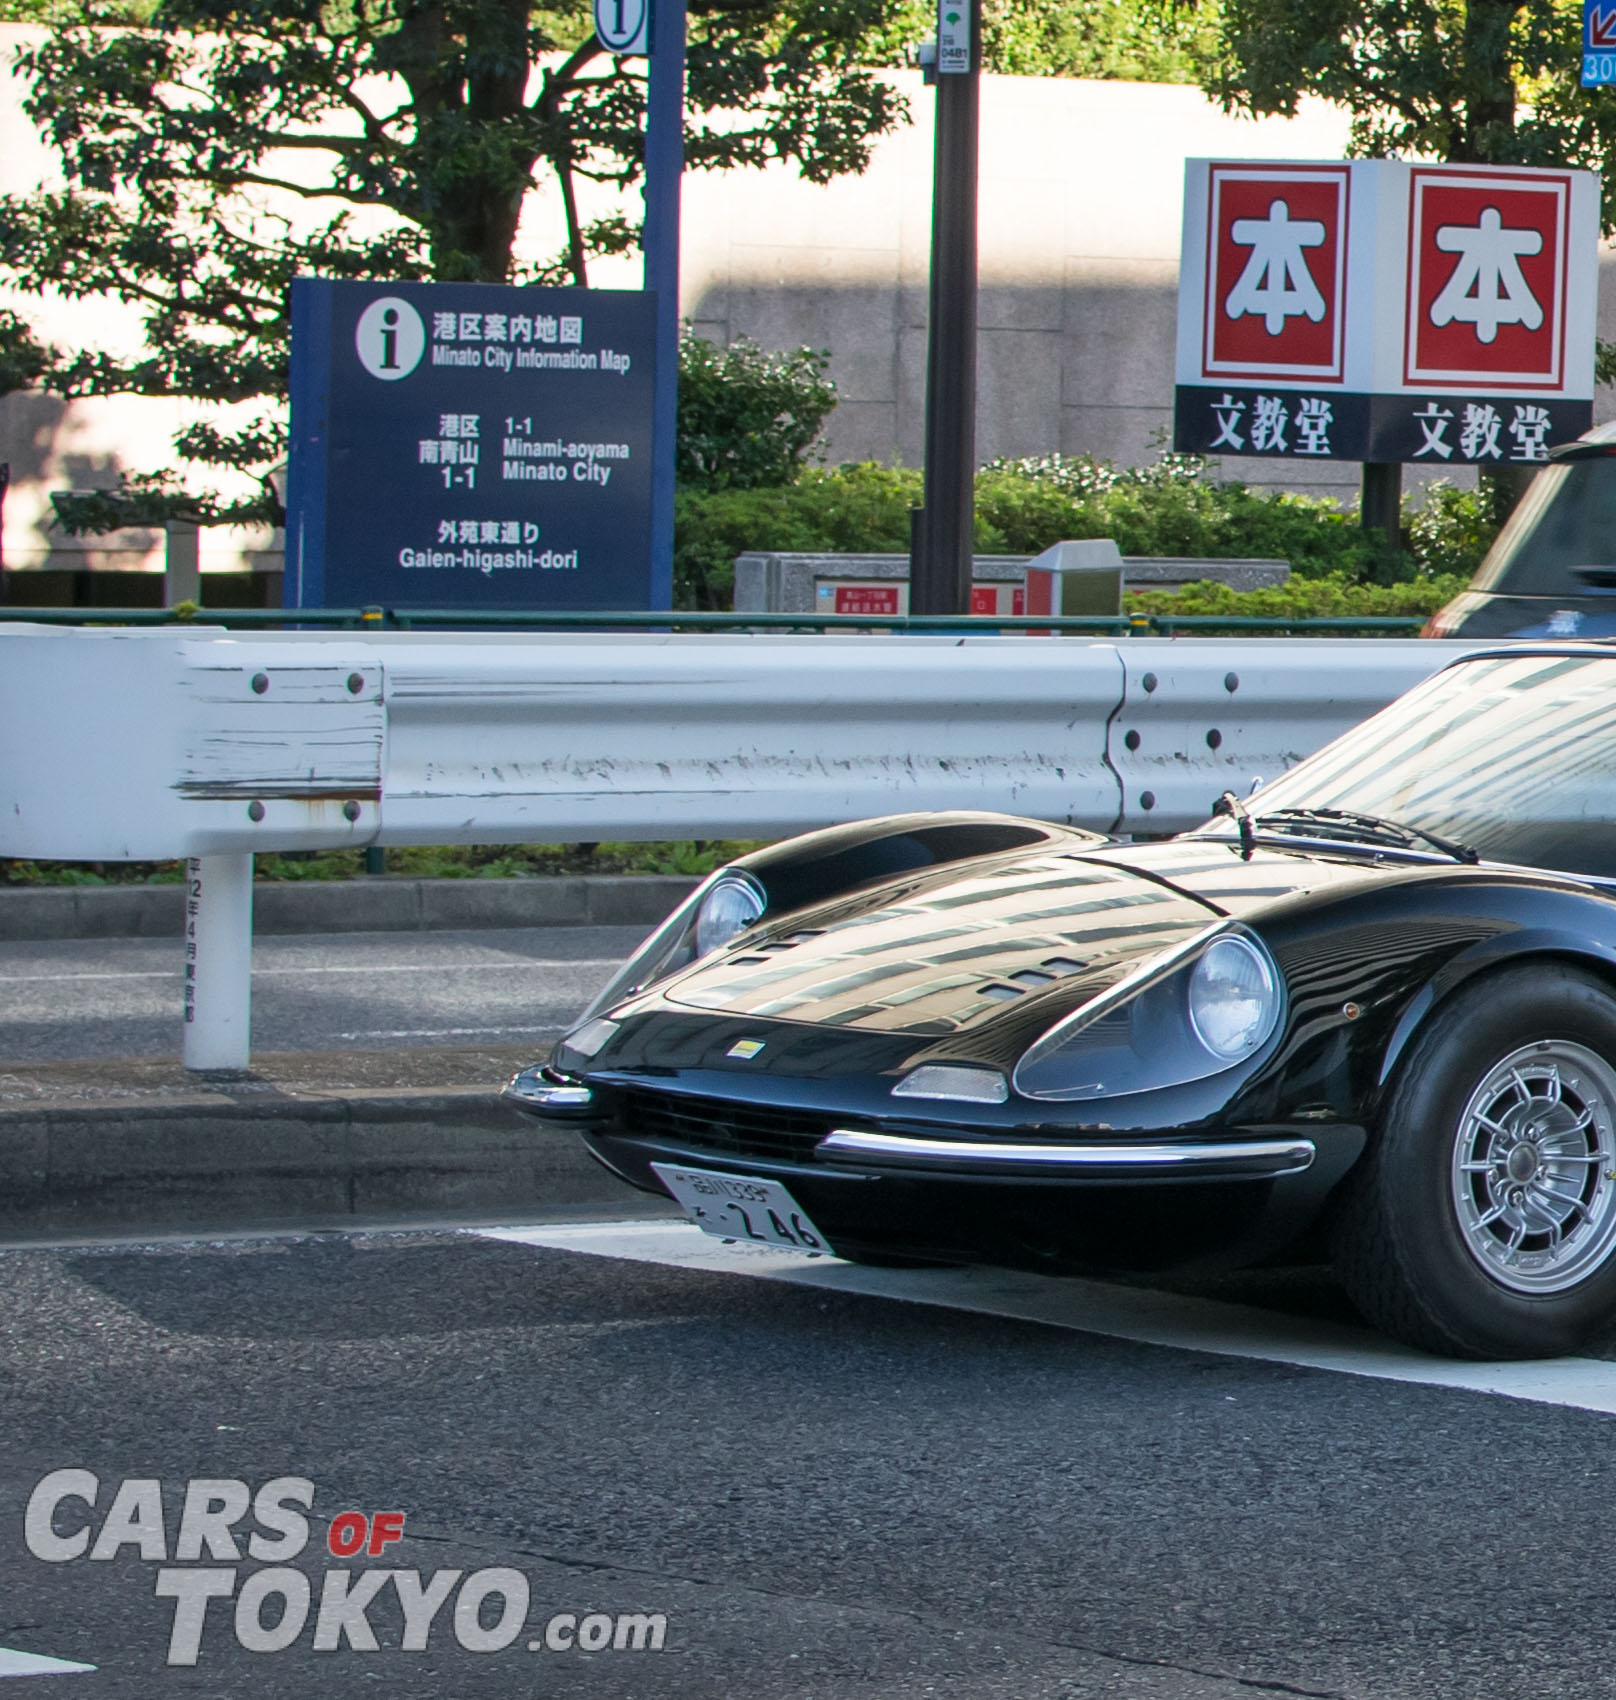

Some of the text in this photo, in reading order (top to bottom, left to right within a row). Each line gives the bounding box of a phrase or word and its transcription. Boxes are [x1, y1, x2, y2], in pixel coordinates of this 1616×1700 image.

[1226, 198, 1326, 337] 本
[1429, 205, 1545, 344] 本
[432, 312, 584, 344] 港区案内地図
[432, 345, 631, 375] Minato City Information Map
[439, 414, 481, 438] 港区
[504, 417, 533, 435] 1-1
[1209, 393, 1335, 455] 文教堂
[1412, 403, 1552, 462] 文教堂
[419, 440, 480, 465] 南青山
[503, 438, 630, 462] Minami-aoyama
[441, 467, 475, 489] 1-1
[503, 461, 612, 486] Minato City
[437, 520, 540, 544] 外苑東通り
[399, 548, 578, 573] Gaien-higashi-dori
